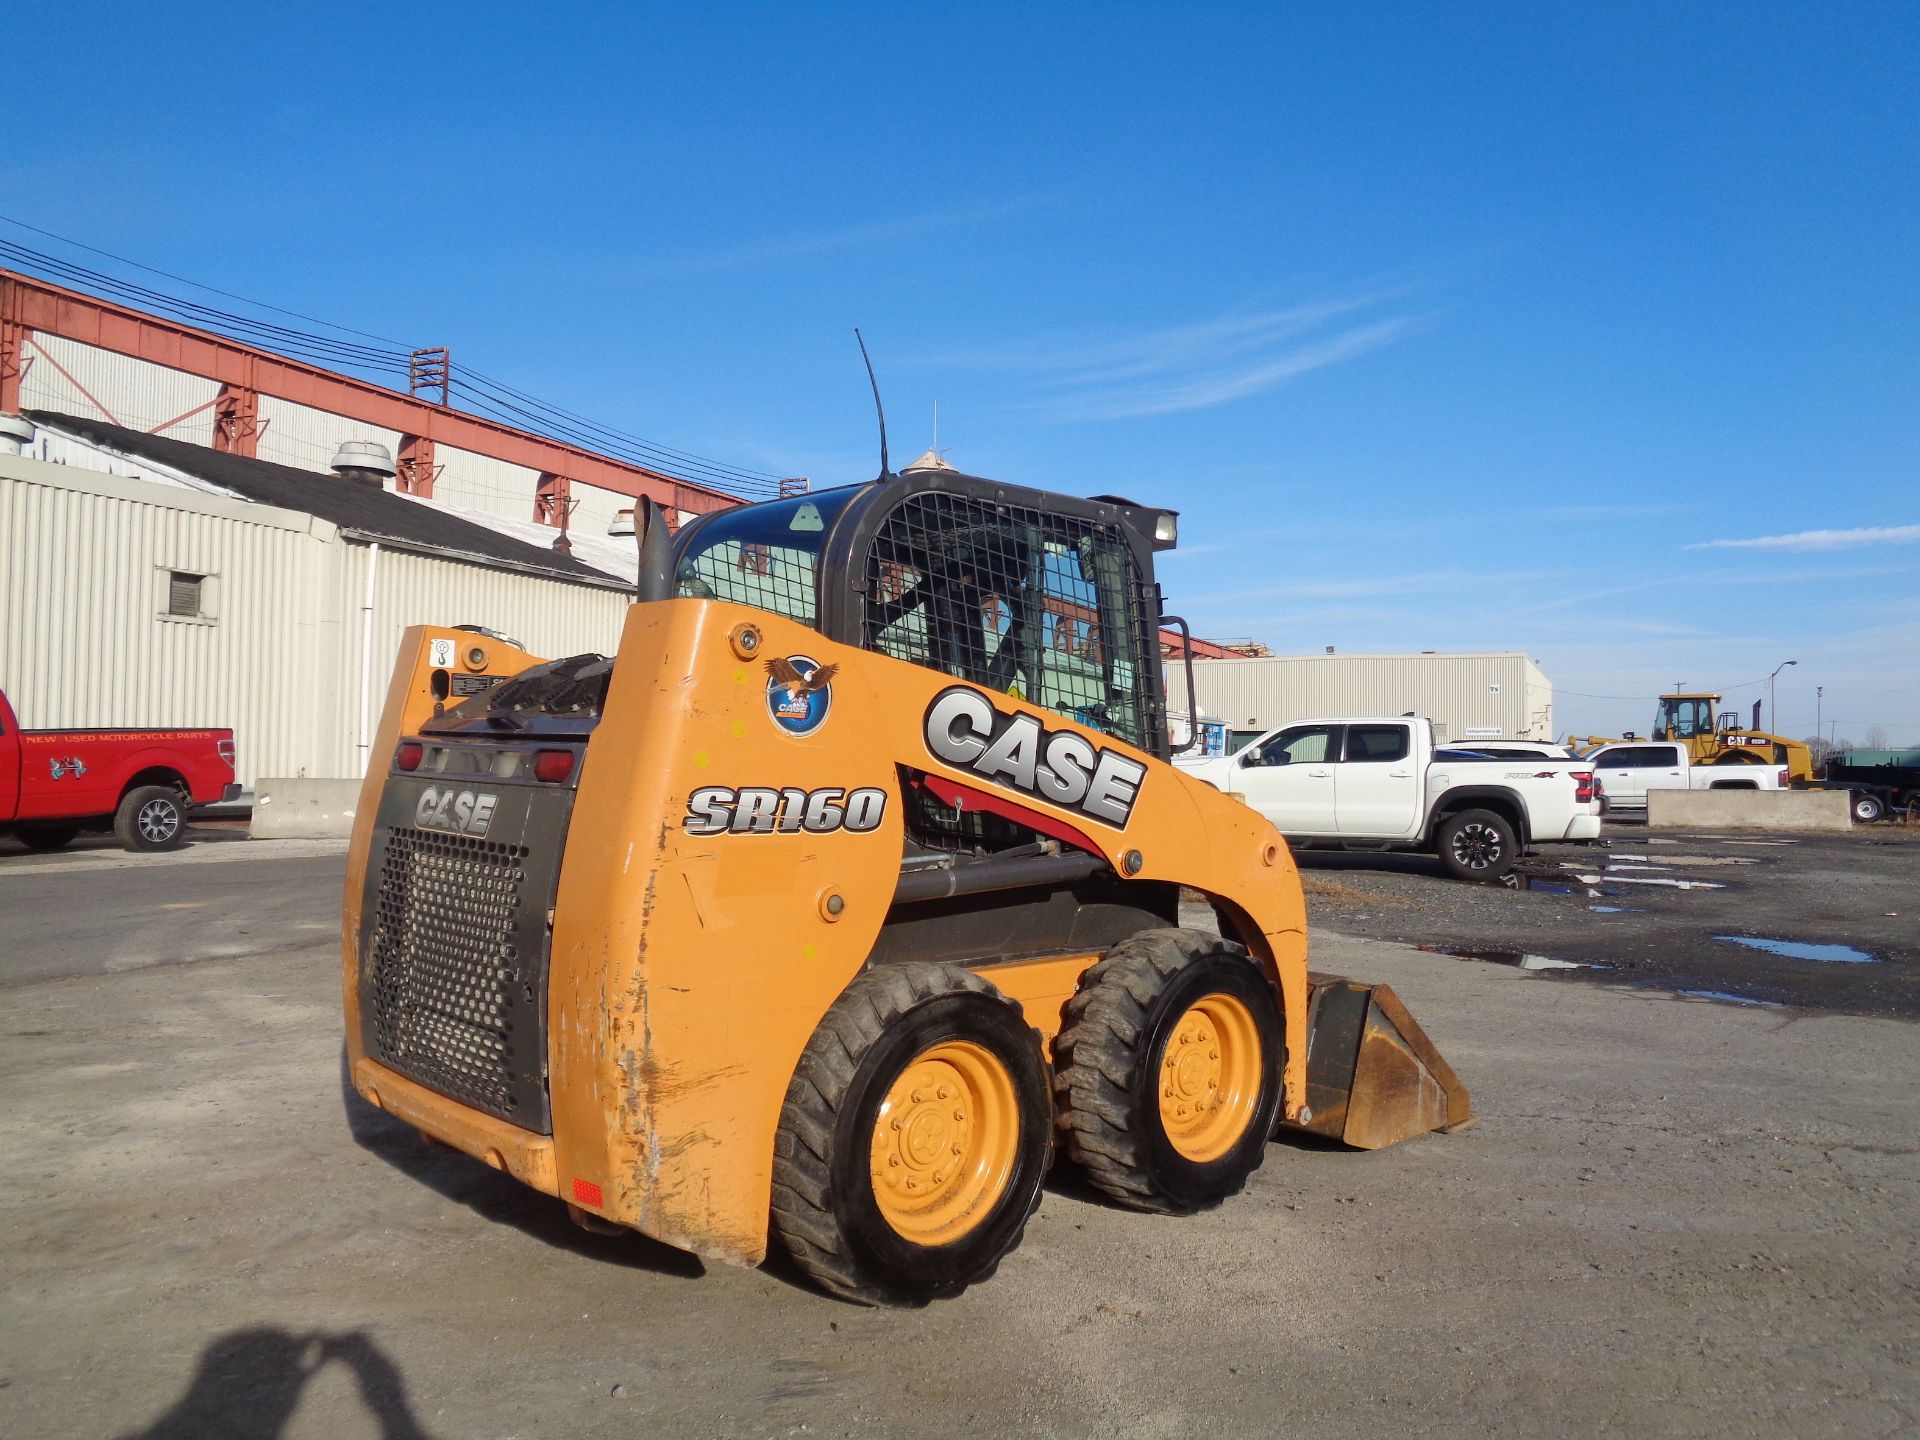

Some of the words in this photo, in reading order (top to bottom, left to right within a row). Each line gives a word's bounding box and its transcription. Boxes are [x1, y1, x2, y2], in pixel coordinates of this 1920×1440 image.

[26, 735, 57, 744] NEW
[64, 734, 96, 743] USED
[99, 733, 173, 742] MOTORCYCLE
[176, 732, 212, 740] PARTS
[926, 687, 1146, 828] CASE
[1727, 735, 1748, 746] CAT
[415, 785, 498, 833] CASE
[683, 786, 888, 837] SR160
